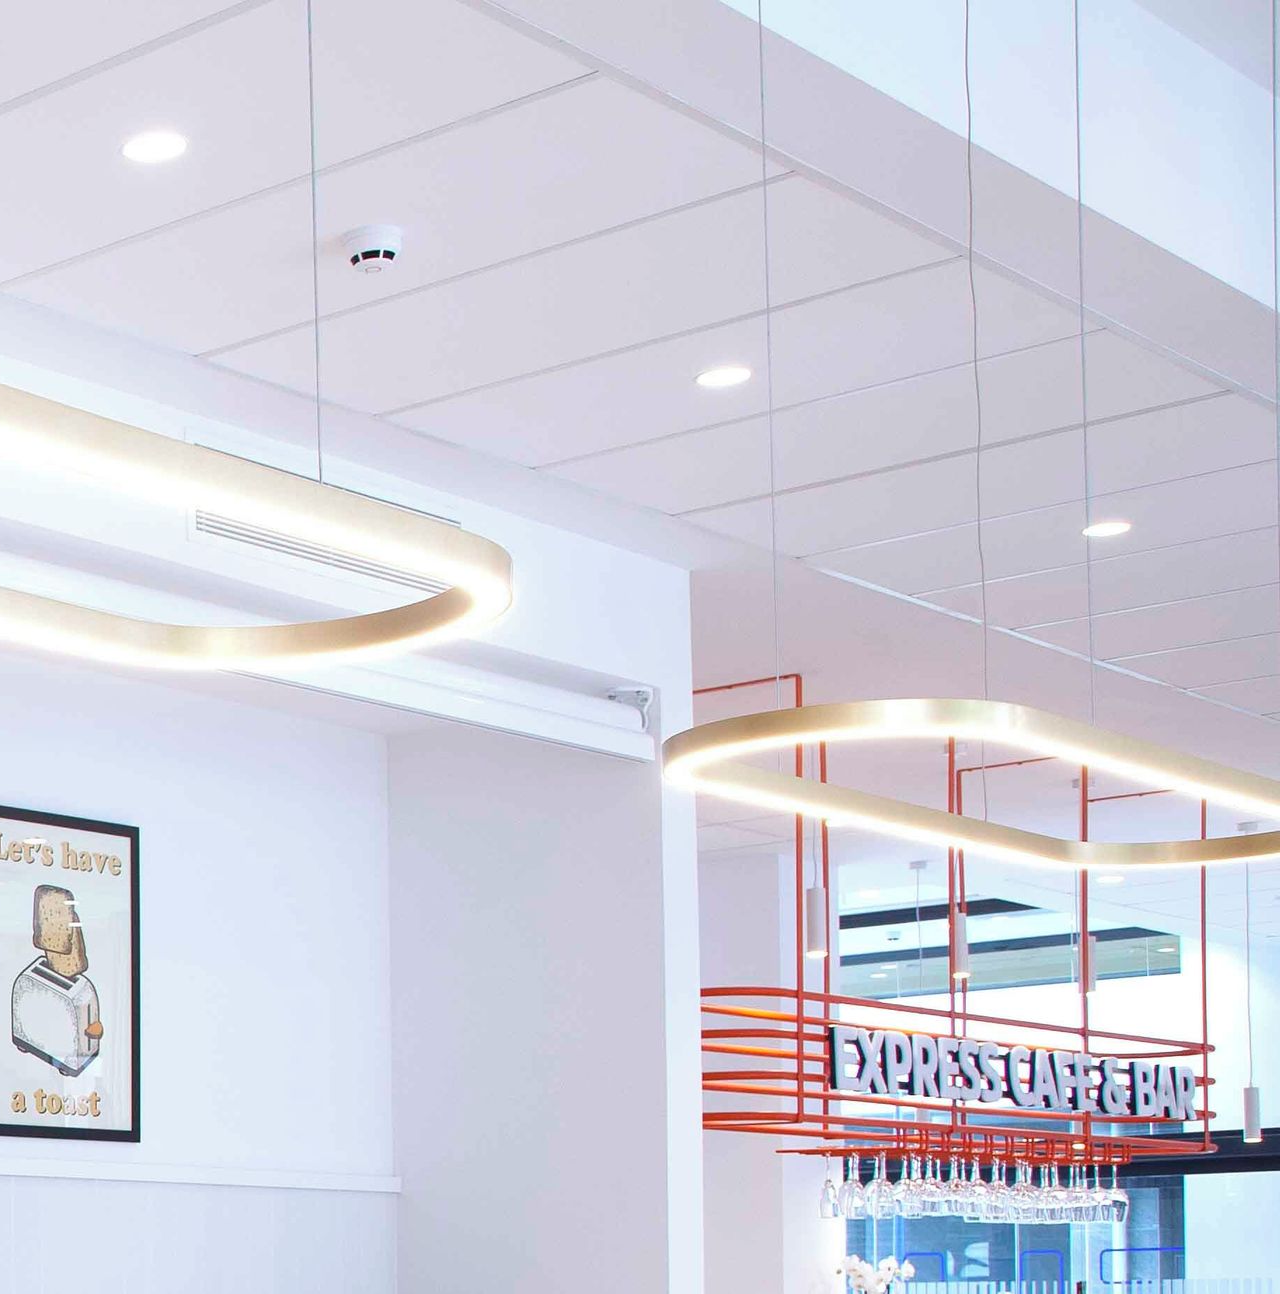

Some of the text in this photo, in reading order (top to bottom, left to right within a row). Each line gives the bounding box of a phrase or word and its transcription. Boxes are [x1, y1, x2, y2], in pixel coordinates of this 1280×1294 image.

[62, 841, 122, 876] have
[829, 1026, 1003, 1103] EXPRESS
[1099, 1057, 1130, 1116] &
[1129, 1061, 1196, 1121] BAR
[11, 1088, 101, 1117] a toast
